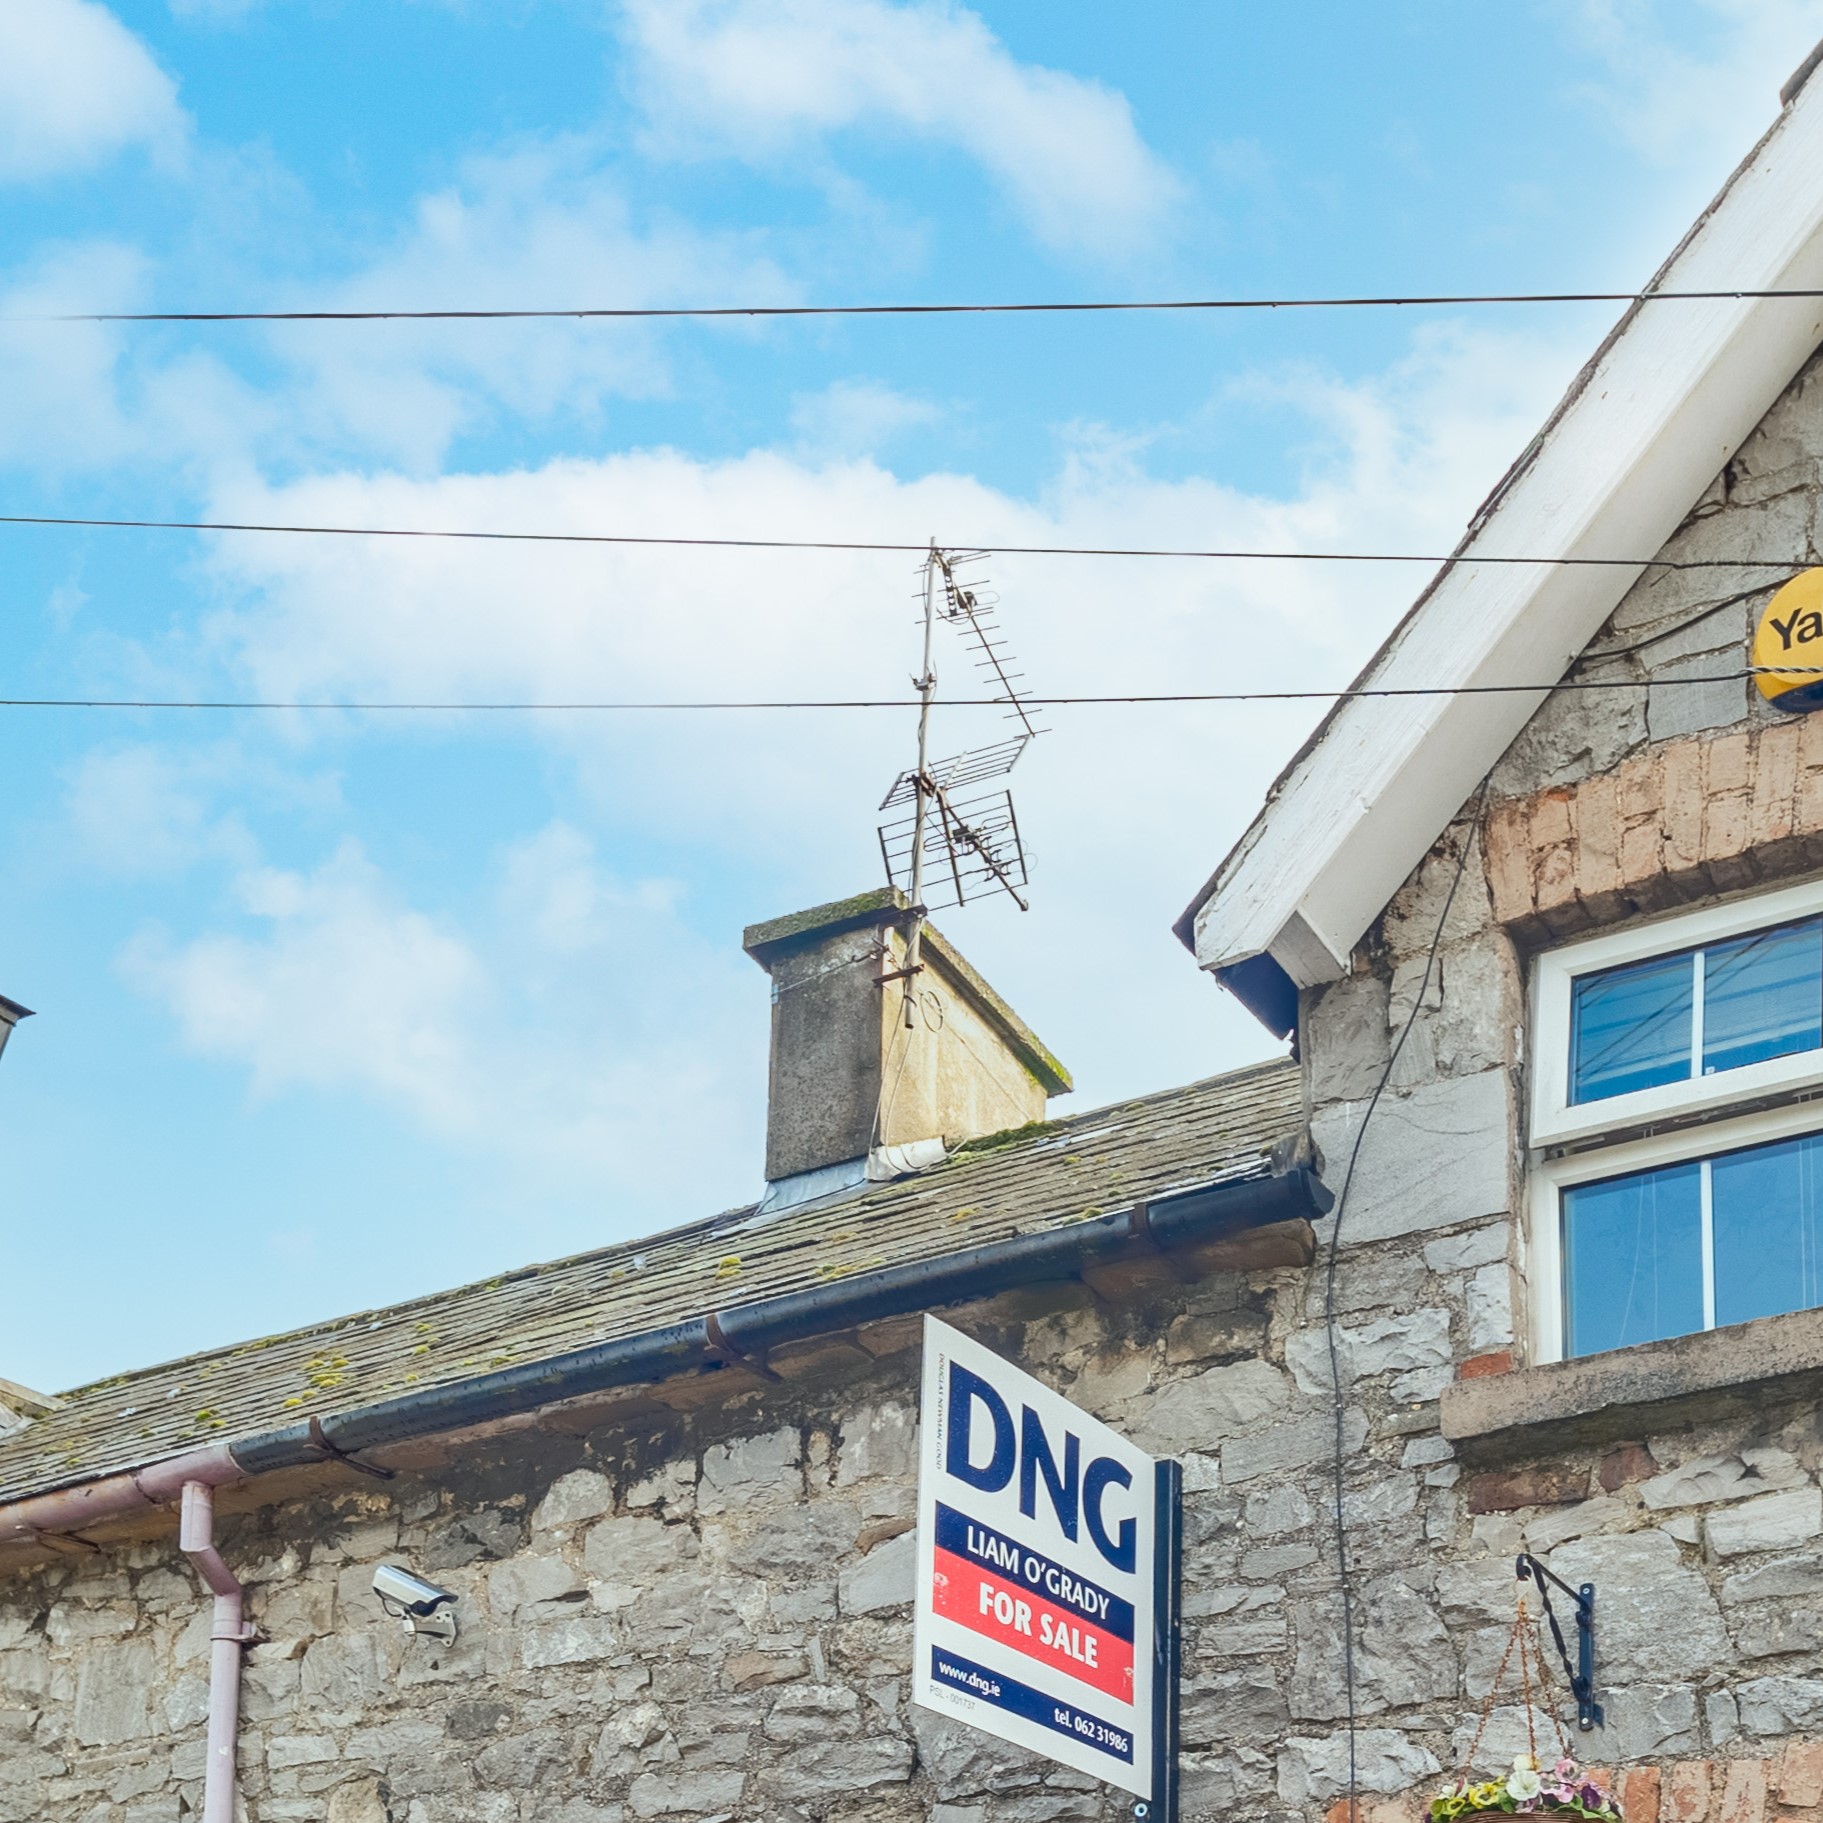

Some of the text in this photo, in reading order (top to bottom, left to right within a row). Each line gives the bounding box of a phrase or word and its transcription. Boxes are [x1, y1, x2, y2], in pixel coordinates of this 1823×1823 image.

[946, 1360, 1137, 1575] DNG
[967, 1525, 1110, 1620] LIAM O'GRADY
[979, 1582, 1098, 1669] FOR SALE
[930, 1684, 944, 1699] PSL
[938, 1661, 1001, 1697] www.dng.ie
[1054, 1707, 1129, 1753] tel. 062 31986
